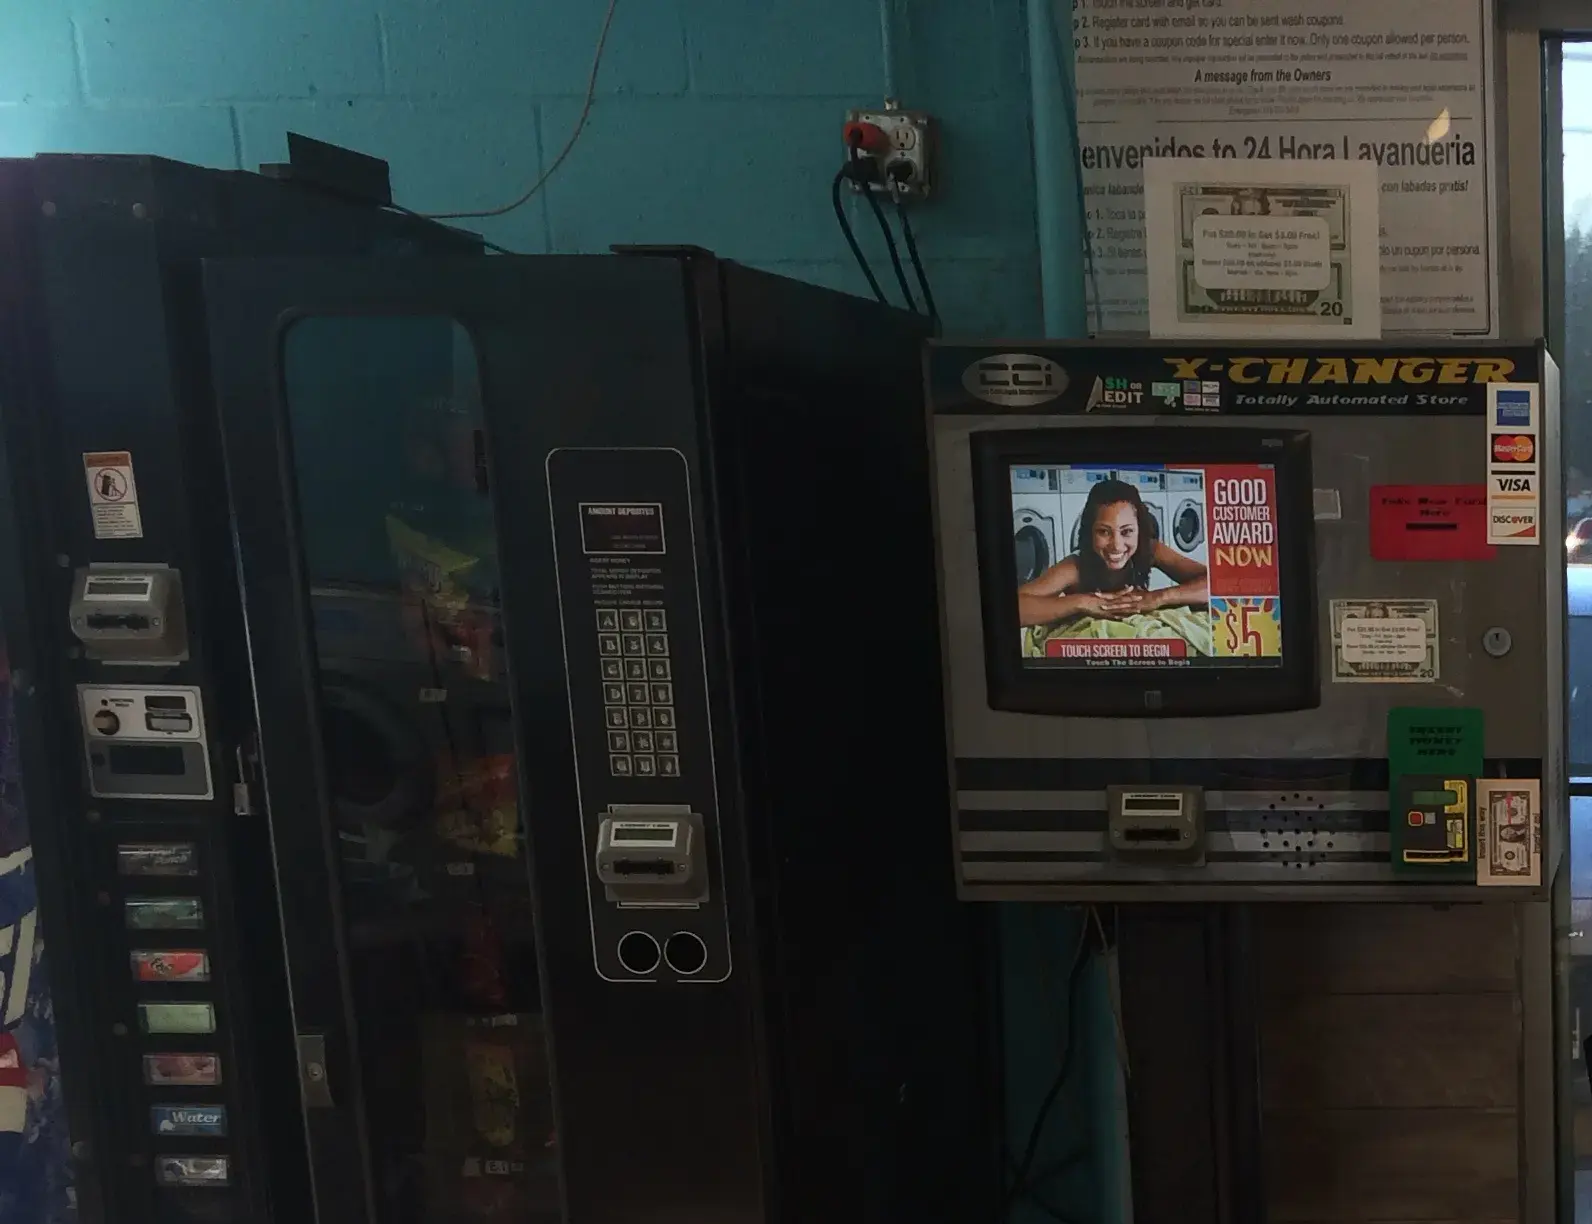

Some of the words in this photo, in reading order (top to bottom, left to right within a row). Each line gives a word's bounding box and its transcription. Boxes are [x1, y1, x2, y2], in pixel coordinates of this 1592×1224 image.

[1131, 16, 1150, 28] card
[1211, 18, 1227, 29] you
[1229, 17, 1245, 27] can
[1246, 16, 1259, 27] be
[1260, 15, 1279, 27] sent
[1281, 14, 1304, 26] wash
[1101, 38, 1117, 50] you
[1118, 36, 1141, 47] have
[1151, 37, 1184, 50] coupon
[1185, 35, 1206, 48] code
[1208, 34, 1221, 47] for
[1223, 34, 1253, 49] special
[1255, 35, 1277, 47] enter
[1310, 33, 1330, 47] Only
[1332, 35, 1349, 45] one
[1351, 34, 1383, 48] coupon
[1420, 34, 1435, 47] per
[1194, 69, 1202, 82] A
[1204, 72, 1248, 85] message
[1250, 69, 1273, 82] from
[1276, 68, 1291, 81] the
[1294, 68, 1331, 81] Owners
[1081, 136, 1205, 169] envenidos
[1243, 136, 1271, 159] 24
[1381, 182, 1399, 192] con
[1401, 180, 1437, 192] labadas
[1320, 302, 1343, 316] 20
[1162, 357, 1516, 384] X-CHANGER
[1234, 393, 1298, 407] Totally
[1306, 393, 1409, 406] Automated
[1415, 393, 1469, 406] Store
[1213, 478, 1267, 505] GOOD
[1496, 479, 1531, 491] VISA
[1212, 506, 1270, 521] CUSTOMER
[1493, 515, 1533, 524] DISCOVER
[1212, 521, 1273, 545] AWARD
[1215, 545, 1273, 568] NOW
[1226, 606, 1262, 657] $5
[1060, 644, 1091, 657] TOUCH
[1093, 644, 1127, 657] SCREEN
[1129, 644, 1141, 657] TO
[1143, 644, 1171, 657] BEGIN
[1168, 659, 1190, 668] Begin
[1419, 668, 1434, 678] 20
[1479, 806, 1487, 821] way
[171, 1111, 221, 1123] Water
